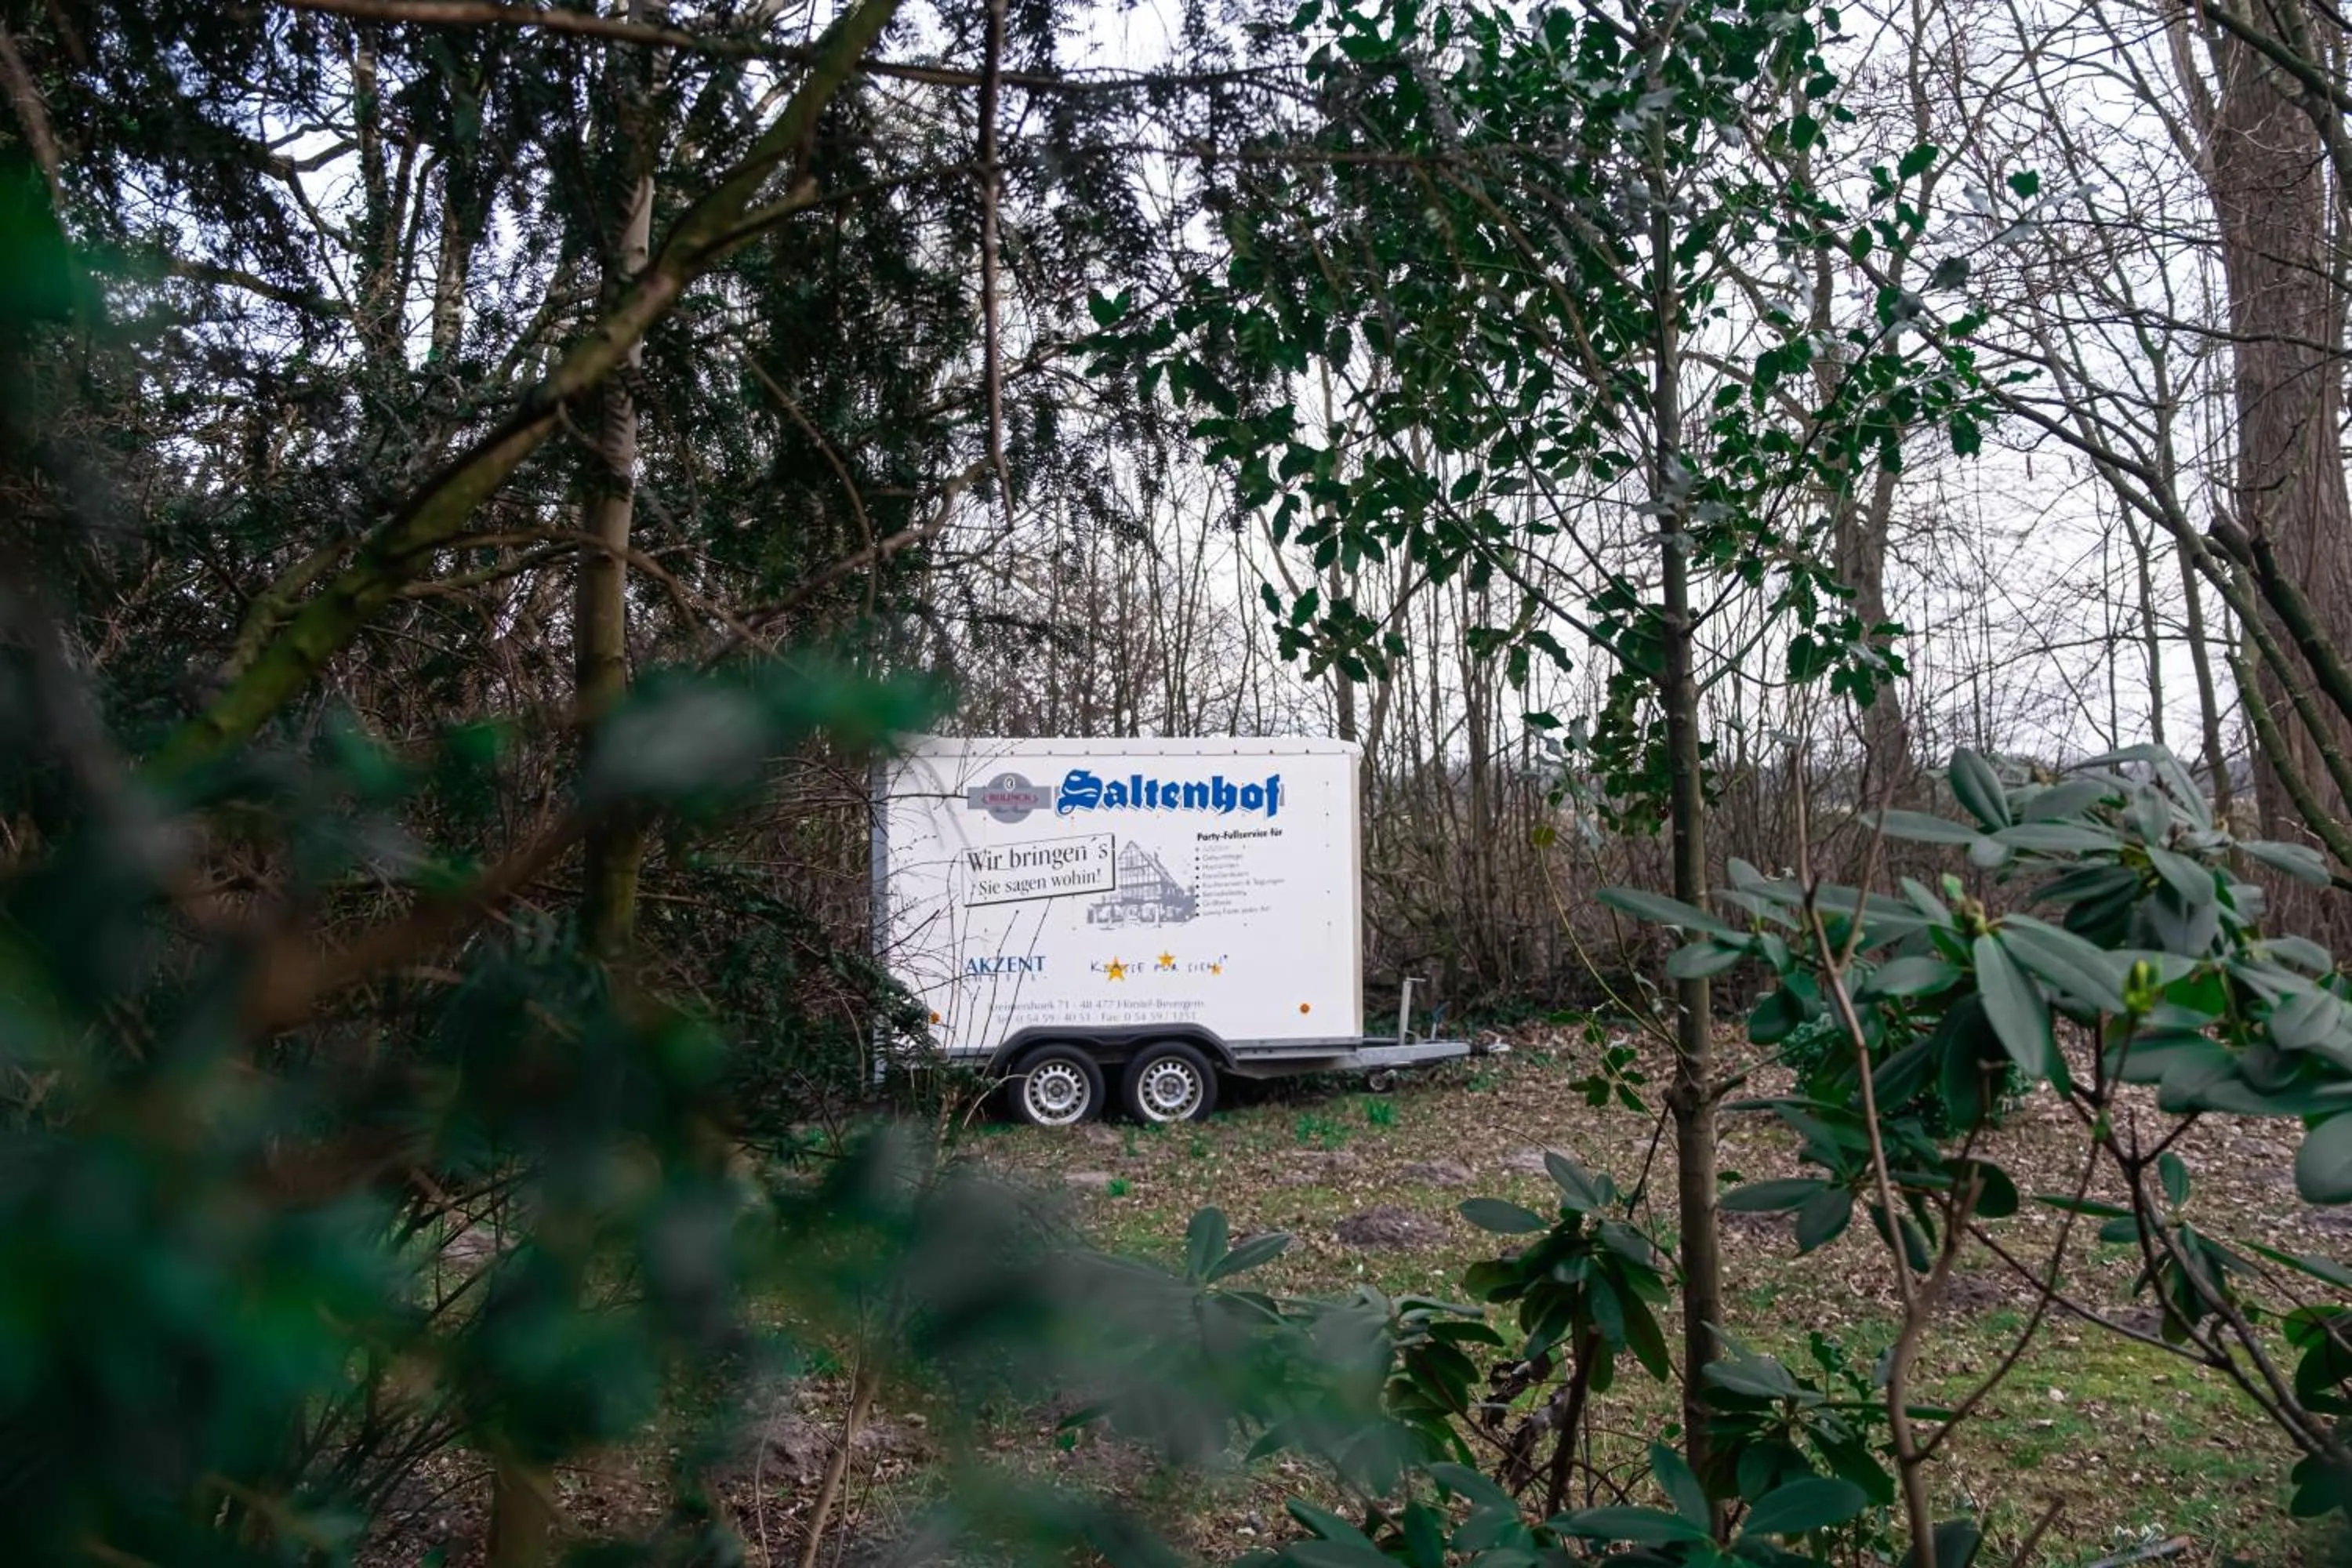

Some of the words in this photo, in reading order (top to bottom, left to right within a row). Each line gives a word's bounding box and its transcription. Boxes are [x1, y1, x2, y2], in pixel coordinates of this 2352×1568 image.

[1058, 769, 1281, 818] Saltenhof
[967, 850, 1003, 873] Wir
[978, 880, 1001, 896] Sie
[1005, 877, 1047, 896] sagen
[966, 956, 1047, 973] AKZENT
